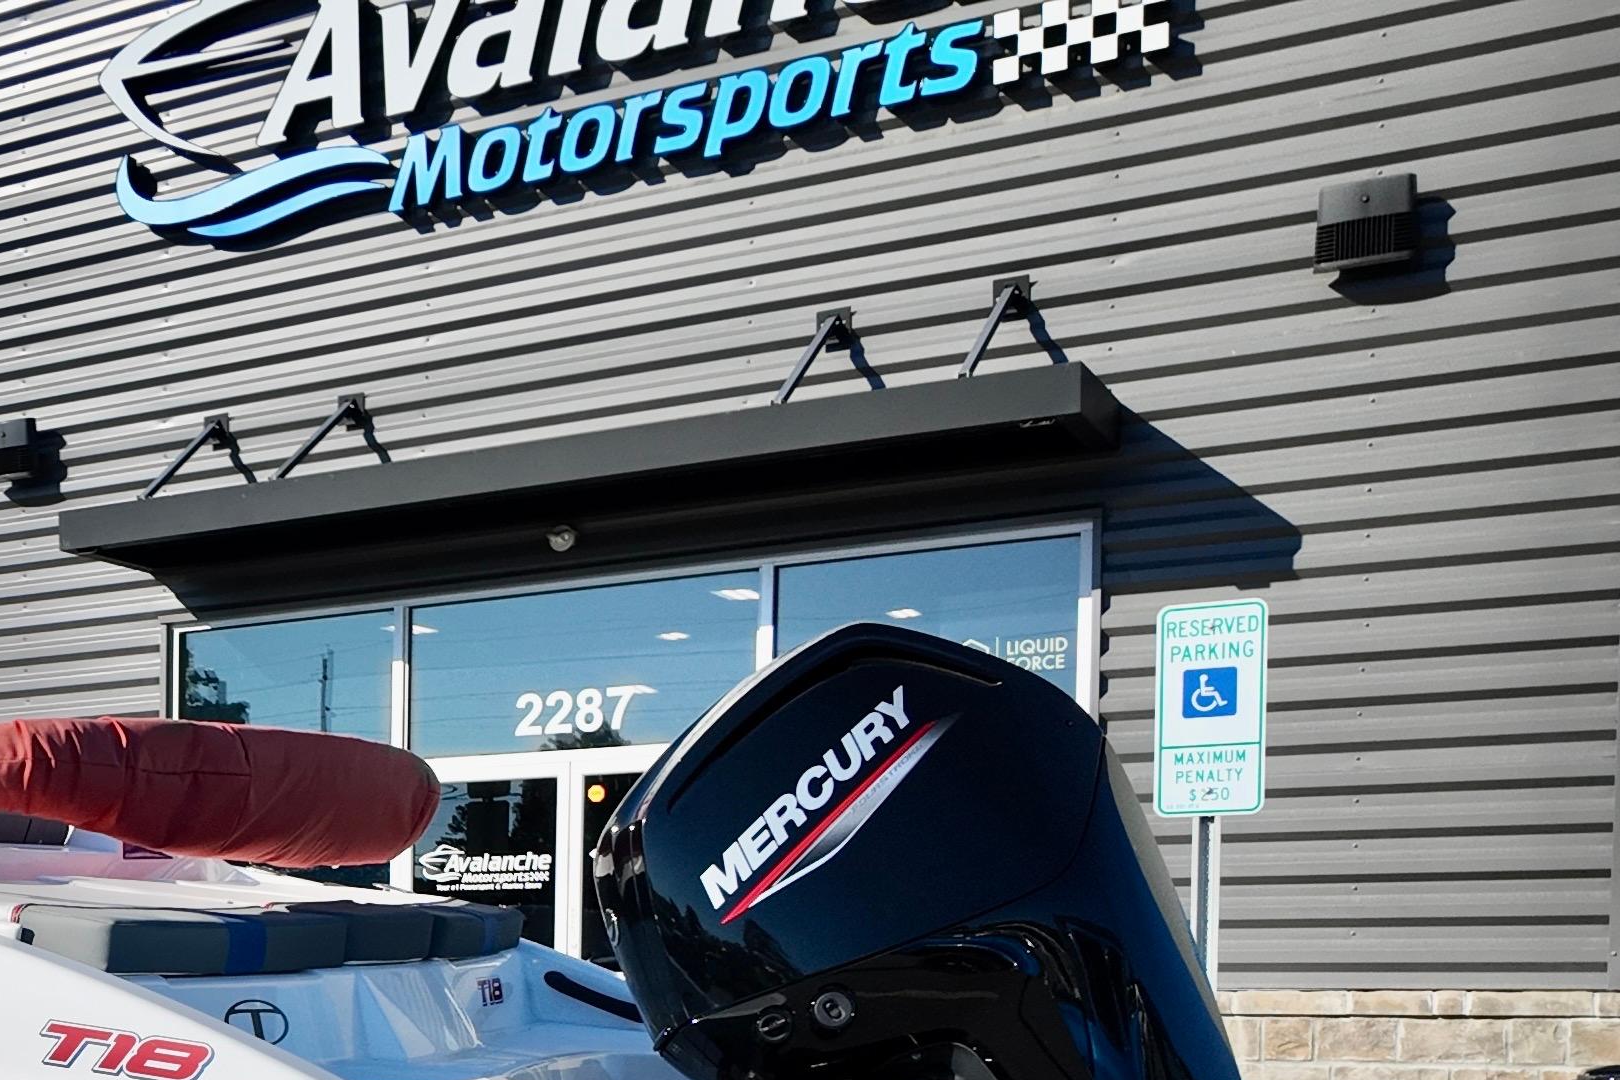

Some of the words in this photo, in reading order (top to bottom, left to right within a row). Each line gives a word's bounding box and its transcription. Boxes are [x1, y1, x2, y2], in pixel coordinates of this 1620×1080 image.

[387, 19, 985, 213] Motorsports
[1165, 614, 1260, 639] RESERVED
[1006, 636, 1069, 656] LIQUID
[1169, 639, 1255, 663] PARKING
[514, 685, 640, 737] 2287
[1173, 748, 1247, 766] MAXIMUM
[1175, 767, 1244, 784] PENALTY
[699, 684, 911, 910] MERCURY
[444, 851, 552, 873] Avalanche
